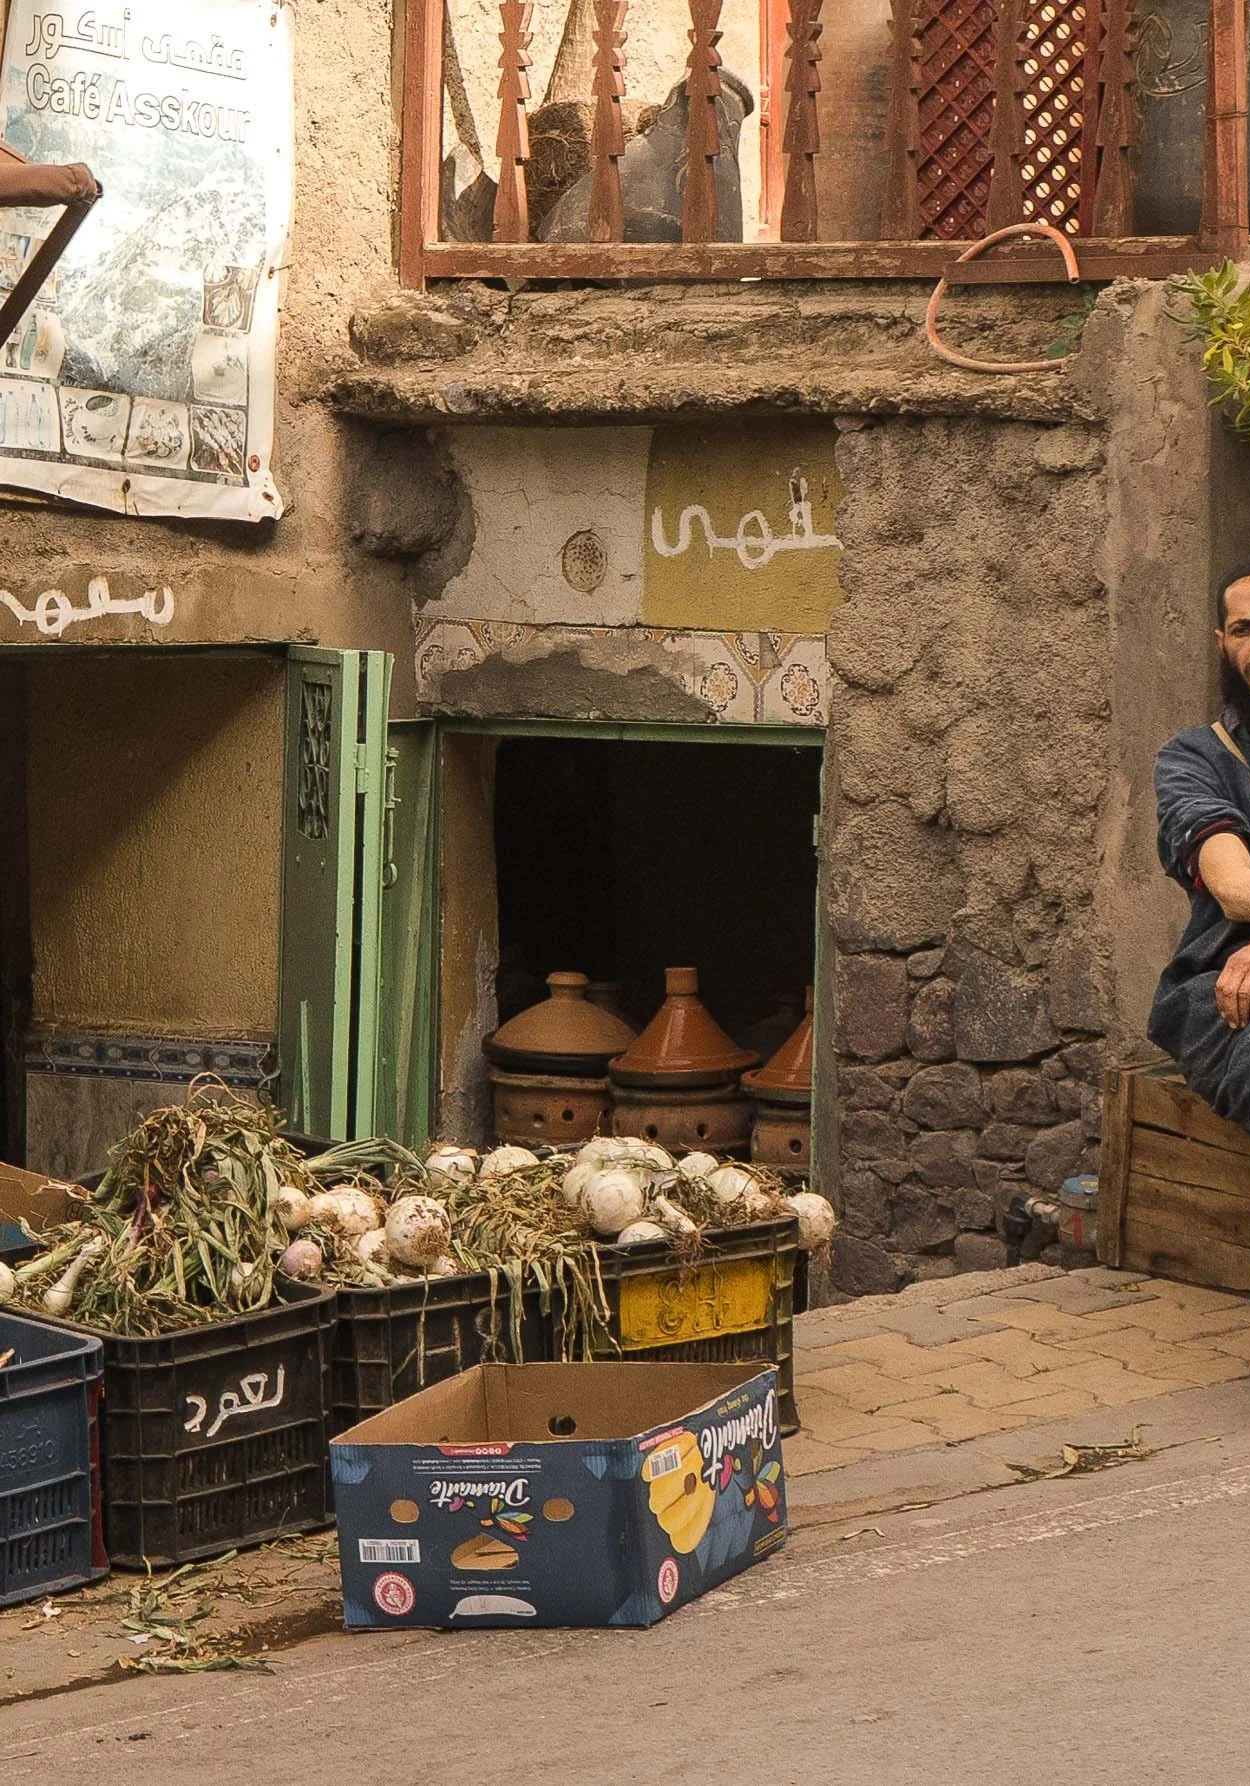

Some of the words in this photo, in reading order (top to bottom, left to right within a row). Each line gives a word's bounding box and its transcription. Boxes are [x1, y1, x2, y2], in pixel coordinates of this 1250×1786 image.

[26, 63, 101, 120] Café
[106, 80, 250, 144] Asskour
[701, 1388, 777, 1486] Diamante
[429, 1478, 531, 1508] Diamante
